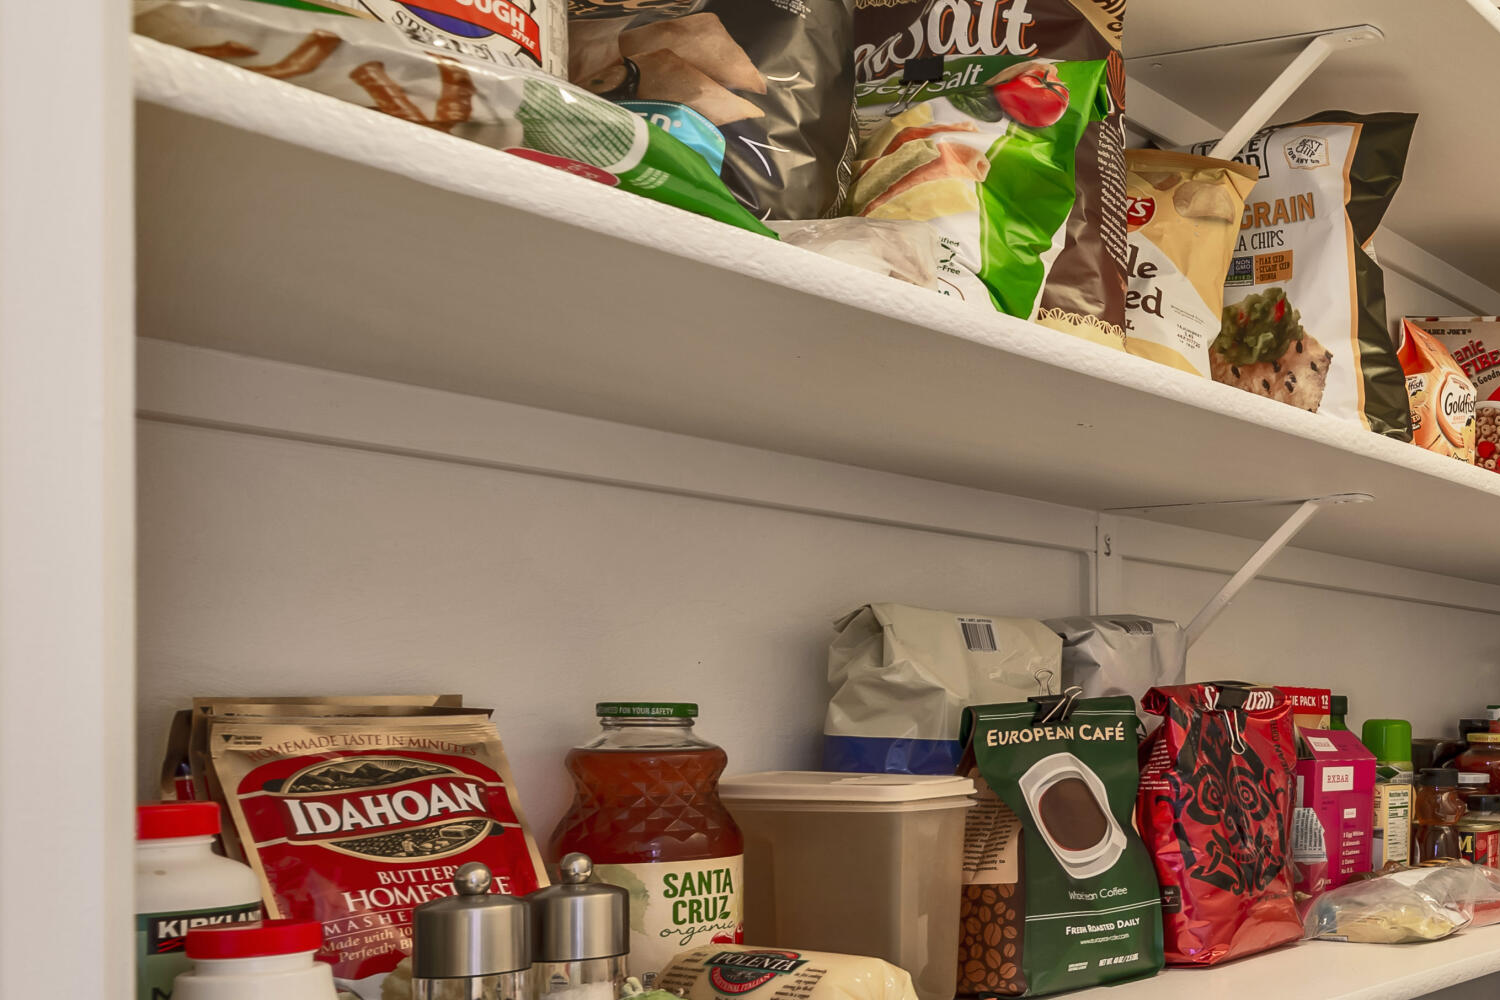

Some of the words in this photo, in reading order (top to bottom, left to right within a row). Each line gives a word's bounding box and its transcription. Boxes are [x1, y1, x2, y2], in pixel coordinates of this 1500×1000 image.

[512, 29, 535, 49] STYLE
[926, 64, 984, 93] Salt
[1295, 146, 1317, 159] CHIP
[1299, 138, 1323, 151] BEST
[1250, 229, 1285, 250] CHIPS
[1235, 258, 1251, 266] NON
[1299, 695, 1317, 707] PACK
[1321, 694, 1329, 705] 12
[651, 707, 674, 716] SAFETY
[986, 725, 1075, 748] EUROPEAN
[1078, 721, 1126, 742] CAFÉ
[247, 735, 341, 762] HOMEMADE
[342, 734, 385, 748] TASTE
[387, 735, 405, 746] IN
[407, 737, 479, 757] MINUTES
[1326, 774, 1350, 784] RXBAR
[283, 782, 487, 836] IDAHOAN
[662, 866, 735, 899] SANTA
[1099, 887, 1128, 899] Coffee
[672, 895, 731, 927] CRUZ
[324, 911, 408, 936] MASHE
[1116, 917, 1140, 929] DAILY
[364, 930, 394, 945] with
[659, 921, 737, 947] organic
[339, 941, 397, 963] Perfectly
[714, 952, 799, 972] POLENTA
[741, 973, 773, 993] ITALIAN
